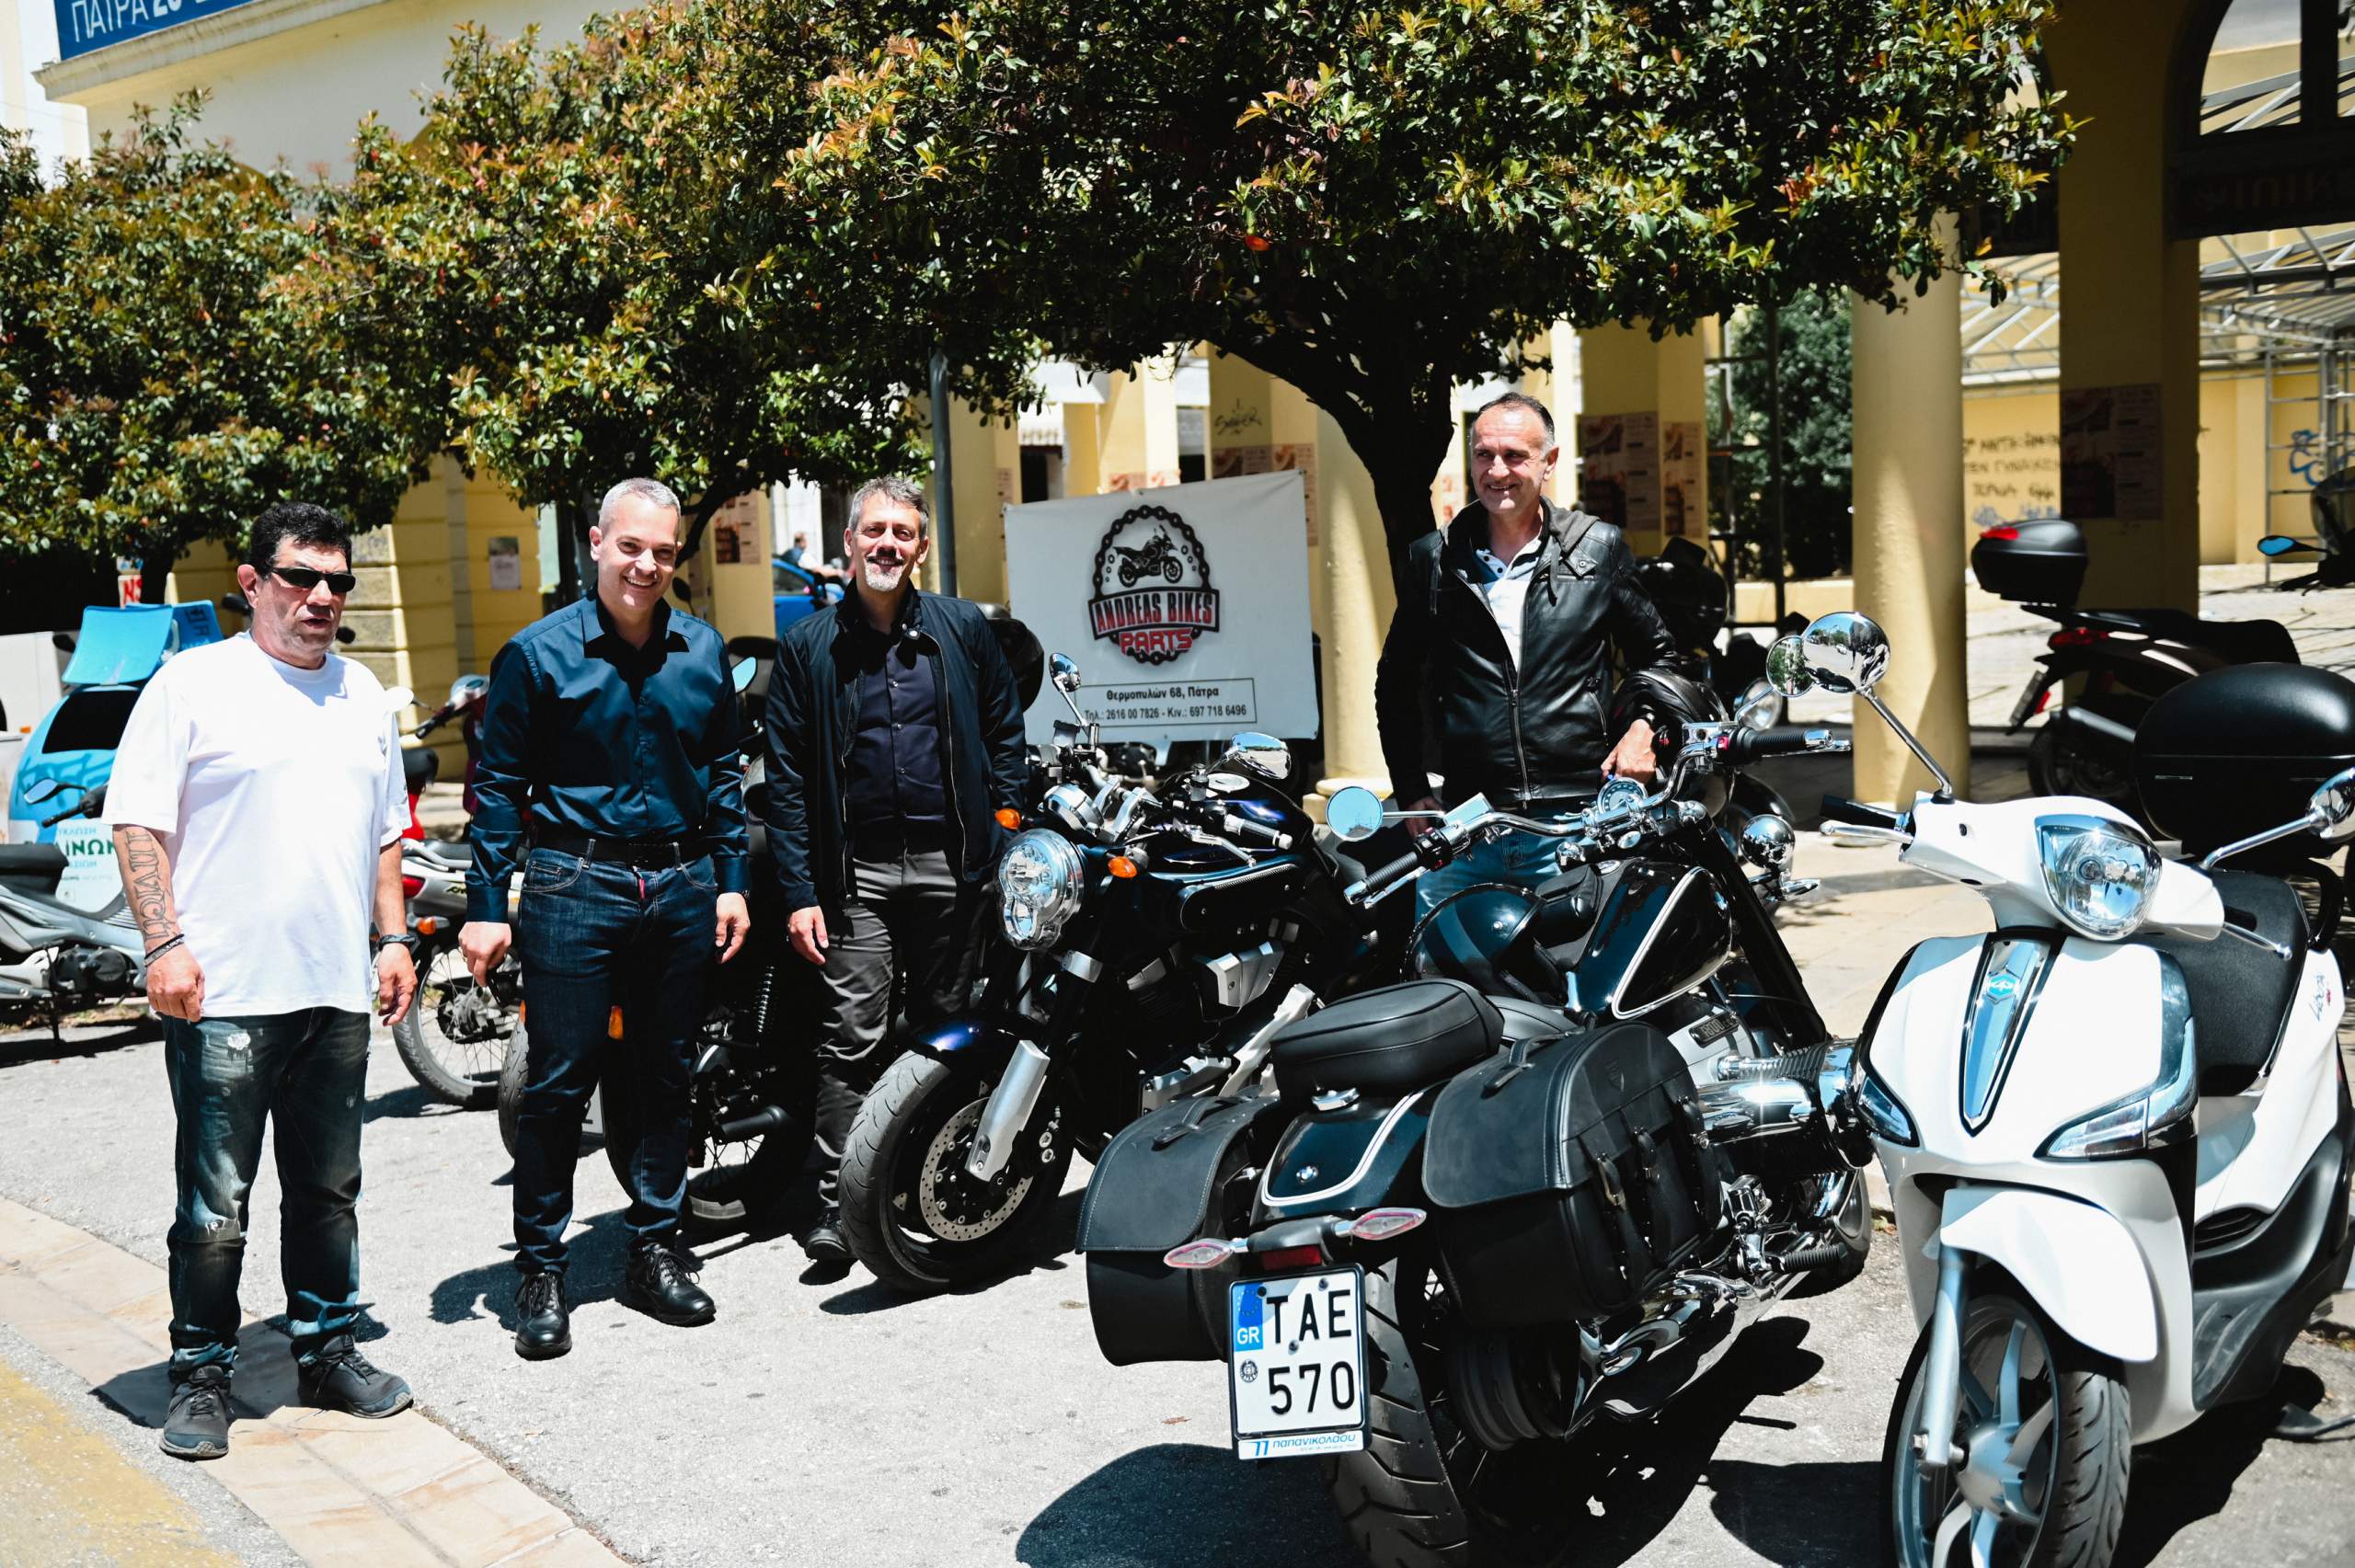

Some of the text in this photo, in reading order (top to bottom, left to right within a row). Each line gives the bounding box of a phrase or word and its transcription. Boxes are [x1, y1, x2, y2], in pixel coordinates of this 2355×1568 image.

[1095, 591, 1212, 633] ANDREAS BIKES
[1119, 627, 1193, 656] PARTS
[1107, 685, 1219, 703] Θερμοπυλών 68, Πάτρα
[1106, 708, 1126, 720] 2616
[1128, 708, 1138, 719] 00
[1140, 707, 1159, 719] 7826
[1207, 705, 1223, 716] 718
[1225, 704, 1246, 716] 6496
[1266, 1289, 1352, 1345] TAE
[1236, 1326, 1260, 1345] GR
[1268, 1361, 1355, 1415] 570
